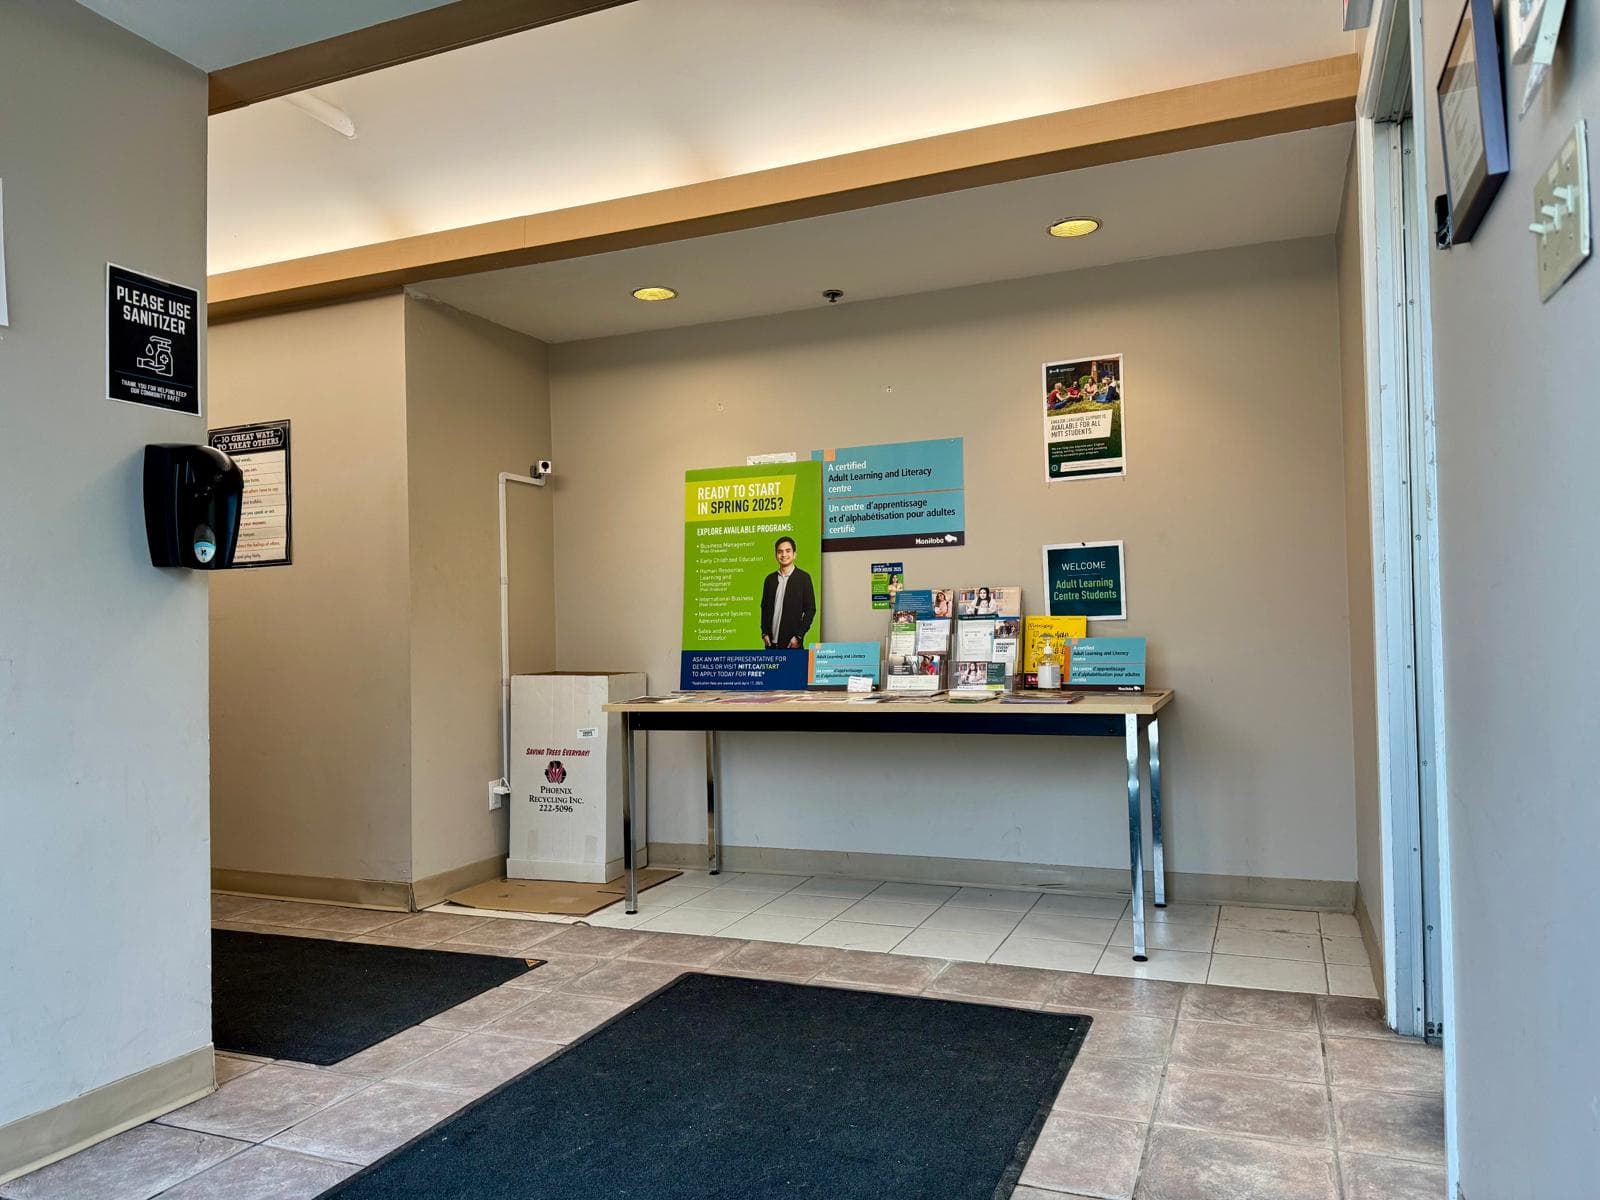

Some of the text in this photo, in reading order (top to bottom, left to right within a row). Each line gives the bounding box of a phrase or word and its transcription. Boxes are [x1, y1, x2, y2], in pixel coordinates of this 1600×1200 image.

[117, 285, 191, 320] PLEASE USE
[123, 305, 186, 335] SANITIZER
[121, 379, 137, 388] THANK
[138, 382, 147, 390] YOU
[157, 387, 175, 396] HELPING
[176, 390, 187, 398] KEEP
[1051, 422, 1079, 431] AVAILABLE
[231, 433, 255, 442] GREAT
[256, 431, 274, 440] WAYS
[1051, 428, 1092, 438] MITT STUDENTS
[217, 437, 279, 451] TO TREAT OTHERS
[828, 460, 867, 472] A certified
[828, 466, 932, 483] Adult Learning and Literacy
[698, 482, 782, 501] READY TO START
[828, 484, 852, 494] centre
[697, 497, 784, 516] IN SPRING 2025?
[828, 498, 928, 513] Un centre d'apprentissage
[828, 515, 837, 523] et
[906, 510, 924, 520] pour
[926, 507, 956, 517] adultes
[697, 523, 794, 536] EXPLORE AVAILABLE PROGRAMS:
[828, 525, 856, 535] certifié
[916, 536, 944, 545] Manitoba
[1061, 561, 1106, 571] WELCOME
[1055, 577, 1114, 590] Adult Learning
[1053, 589, 1117, 601] Centre Students
[731, 610, 752, 618] Systems
[526, 747, 591, 757] SAVING TREES EVERYDAY!
[540, 786, 573, 795] PHOENIX
[529, 795, 585, 804] RECYCLING INC.
[539, 804, 574, 813] 222-5096
